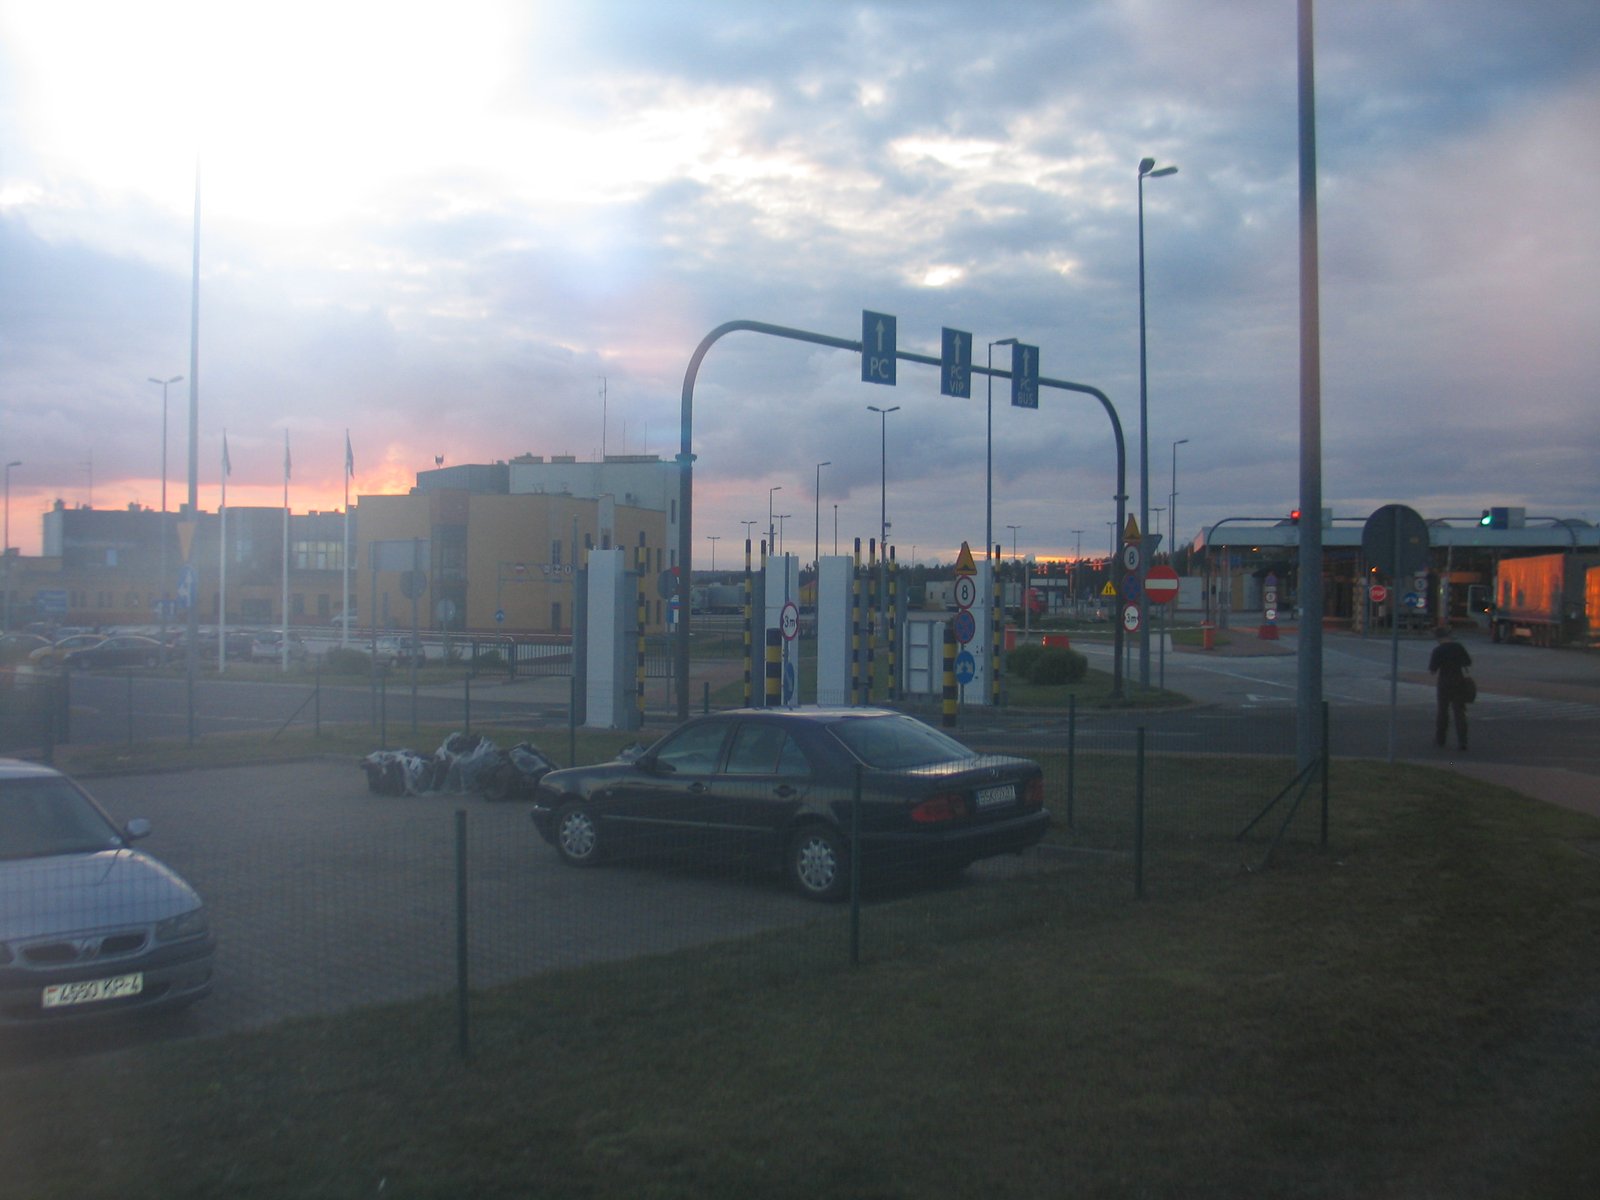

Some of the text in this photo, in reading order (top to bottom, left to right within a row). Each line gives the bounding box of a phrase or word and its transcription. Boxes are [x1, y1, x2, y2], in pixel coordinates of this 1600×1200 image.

[870, 356, 889, 379] PC
[950, 365, 963, 379] PC
[949, 380, 965, 395] VIP
[1020, 377, 1031, 391] PC
[1017, 391, 1035, 406] BUS
[1128, 552, 1135, 565] 8
[961, 584, 968, 600] 8
